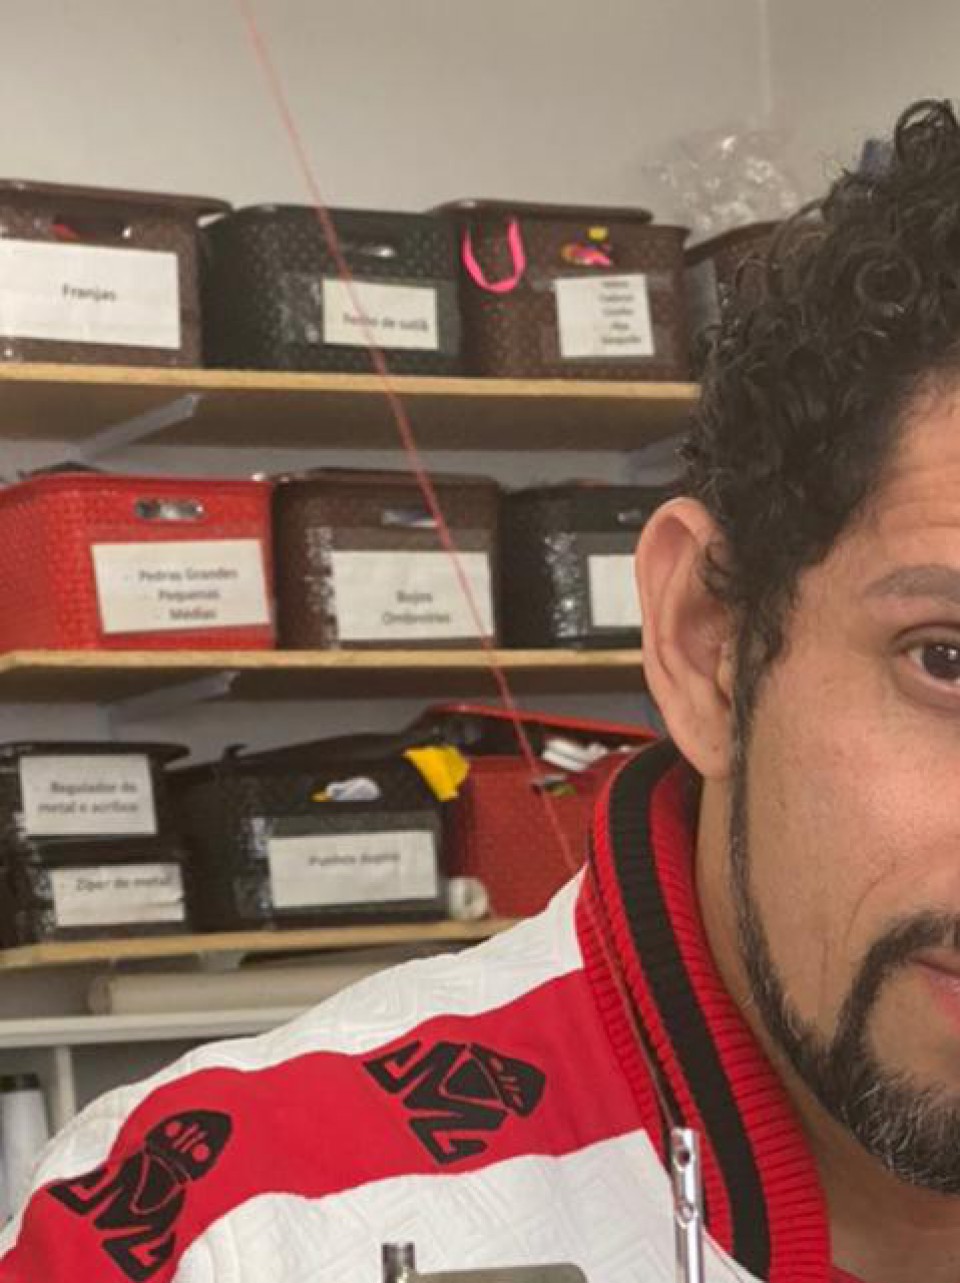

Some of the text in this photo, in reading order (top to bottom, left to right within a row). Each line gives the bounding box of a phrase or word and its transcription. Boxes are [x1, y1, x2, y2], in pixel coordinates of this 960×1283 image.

[61, 283, 115, 302] Franjas
[138, 566, 238, 583] Pedras Grandes
[49, 781, 116, 797] Regulador
